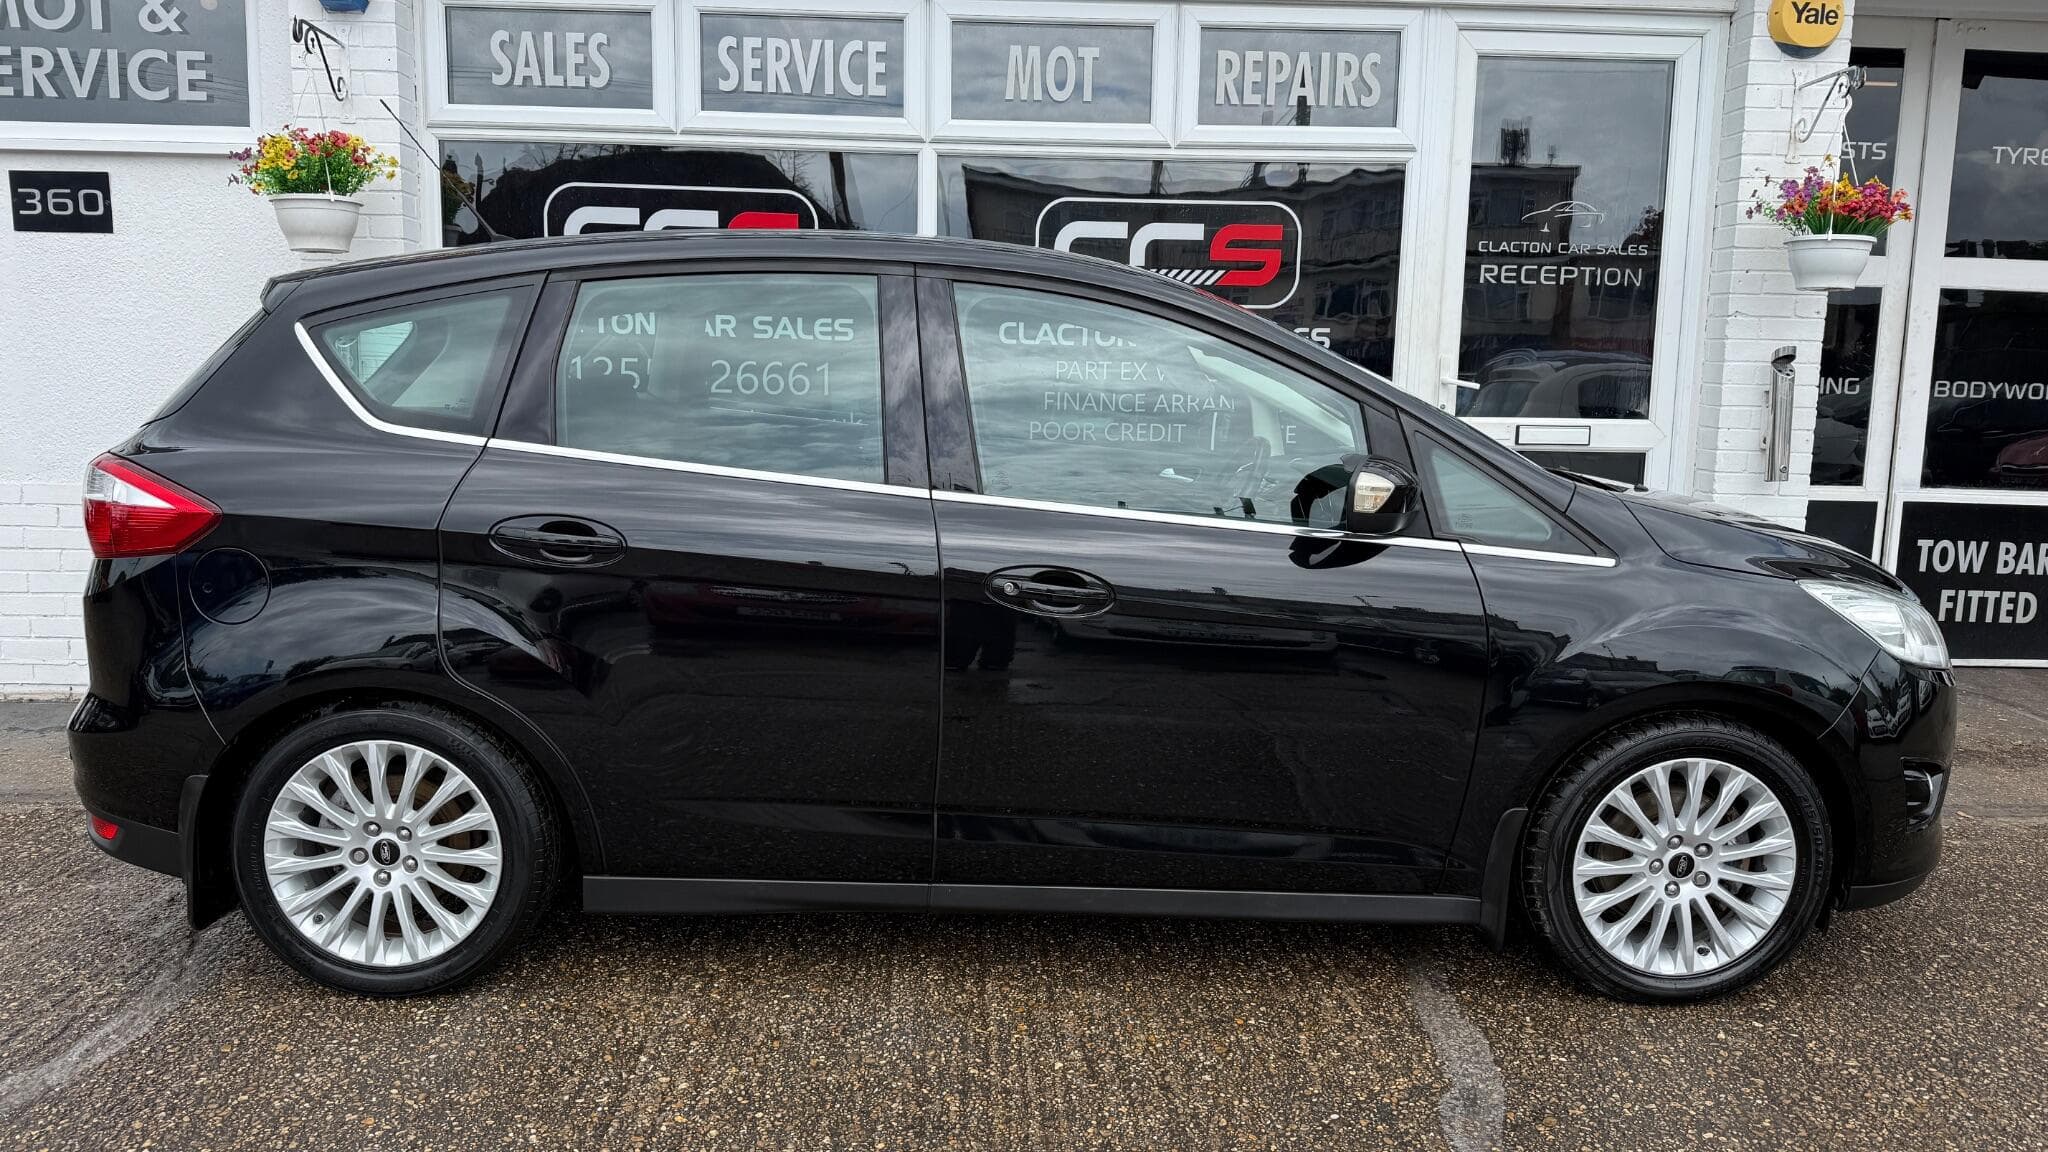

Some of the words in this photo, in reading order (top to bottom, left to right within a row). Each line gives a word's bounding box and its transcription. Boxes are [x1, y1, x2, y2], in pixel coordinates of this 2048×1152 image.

[1791, 1, 1839, 26] Yale
[489, 29, 611, 88] SALES
[717, 35, 888, 97] SERVICE
[1004, 45, 1100, 102] MOT
[1215, 49, 1382, 107] REPAIRS
[17, 188, 104, 216] 360
[1478, 240, 1551, 254] CLACTON
[1558, 242, 1590, 255] CAR
[1596, 244, 1649, 256] SALES
[1479, 264, 1643, 287] RECEPTION
[752, 315, 855, 342] SALES
[710, 359, 830, 396] 26661
[1055, 360, 1113, 381] PART
[1120, 361, 1148, 381] EX
[1044, 391, 1146, 412] FINANCE
[1933, 380, 2048, 400] BODYWO
[1029, 420, 1097, 441] POOR
[1104, 422, 1187, 443] CREDIT
[1917, 539, 1990, 574] TOW
[1938, 589, 2038, 624] FITTED
